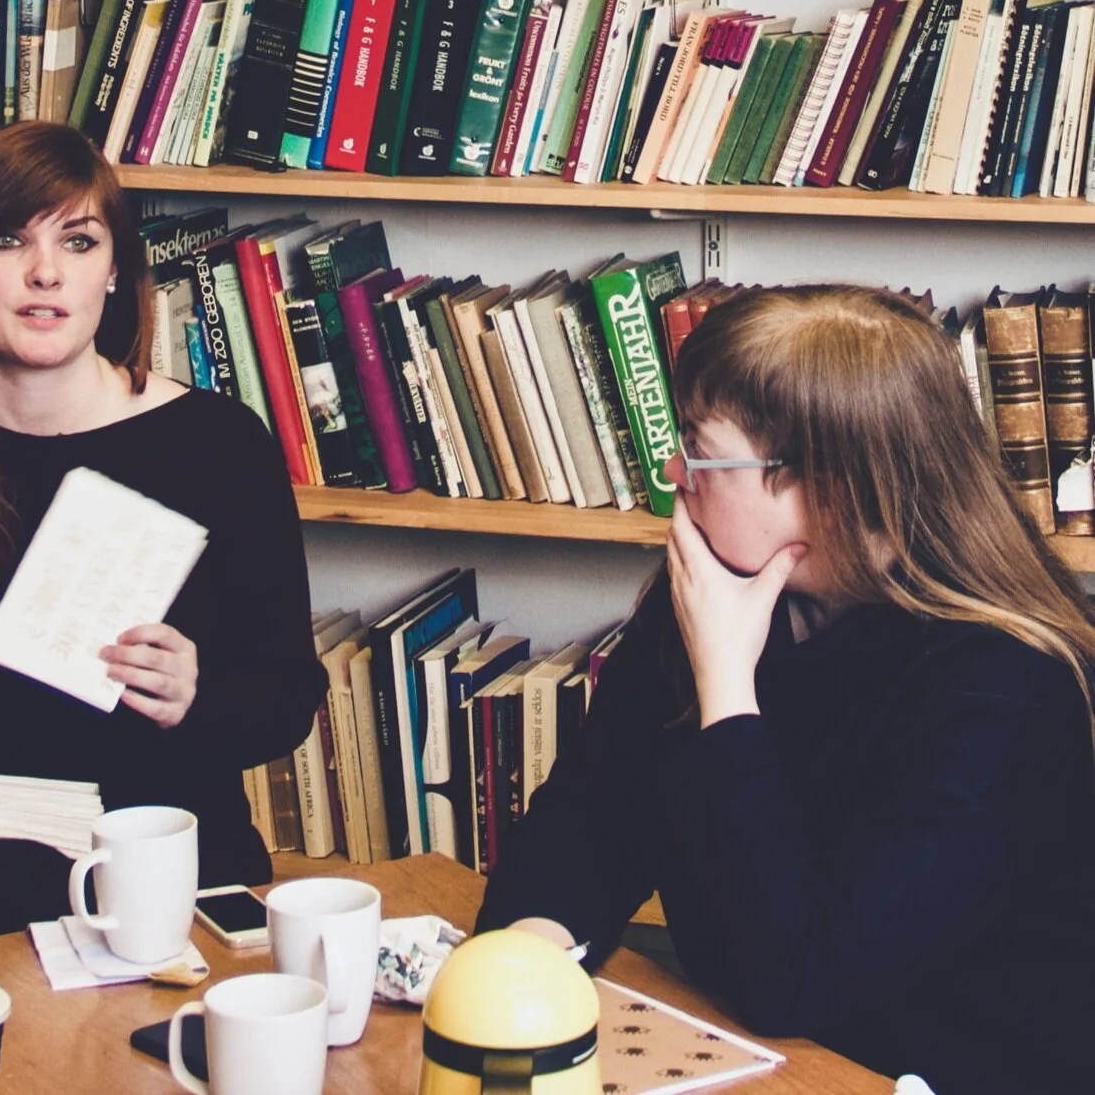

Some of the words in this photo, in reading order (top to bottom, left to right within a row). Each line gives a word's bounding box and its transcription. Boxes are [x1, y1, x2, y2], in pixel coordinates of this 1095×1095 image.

[125, 0, 135, 10] OF
[448, 0, 454, 9] 3
[108, 10, 132, 68] INGREDIENTS
[334, 10, 346, 40] Biology
[332, 42, 340, 51] of
[521, 20, 542, 67] Uncommon
[592, 22, 609, 67] VEGETABLES
[1009, 24, 1030, 92] Sötningslexikon
[1022, 24, 1043, 92] Sötningslexikon
[21, 59, 31, 76] der
[327, 52, 338, 84] Brassica
[354, 47, 371, 88] HANDBOK
[390, 51, 403, 91] HANDBOK
[433, 51, 448, 92] HANDBOK
[478, 56, 506, 69] FRUKT
[590, 68, 598, 78] IN
[674, 48, 690, 72] JORD
[20, 77, 31, 98] Aus
[472, 73, 505, 87] GRÖNT
[517, 67, 531, 90] Fruits
[667, 74, 681, 94] TILL
[469, 89, 500, 103] lexikon
[658, 96, 674, 121] BORD
[202, 106, 214, 140] JORDEN
[507, 102, 523, 124] Every
[502, 125, 517, 154] Garden
[196, 255, 220, 325] GEBOREN
[210, 327, 227, 360] ZOO
[624, 377, 638, 406] MEIN
[301, 761, 313, 788] SOUTH
[304, 790, 316, 819] AFRICA
